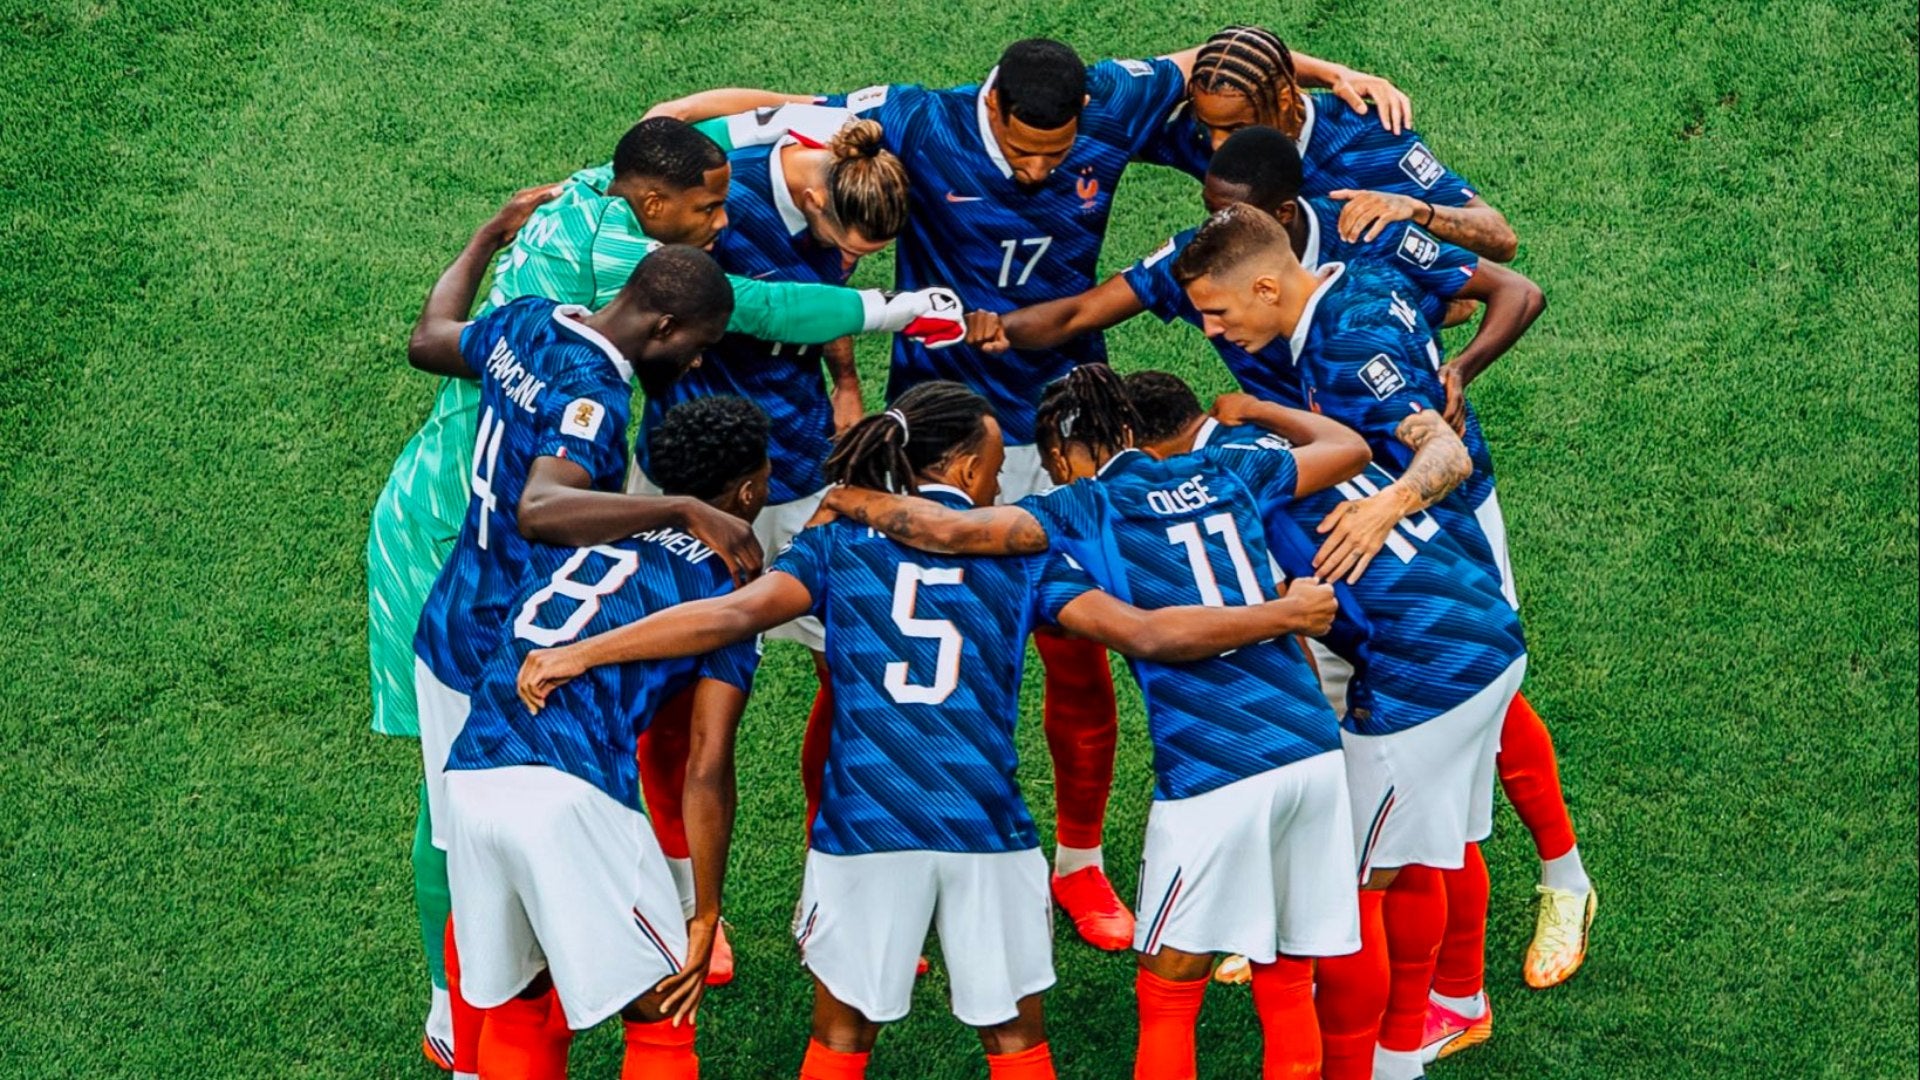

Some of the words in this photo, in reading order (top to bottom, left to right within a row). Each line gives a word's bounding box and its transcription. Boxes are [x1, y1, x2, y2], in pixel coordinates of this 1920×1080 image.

[998, 236, 1053, 288] 17
[471, 405, 505, 550] 4
[514, 544, 639, 648] 8
[1165, 512, 1265, 607] 11
[883, 562, 965, 705] 5
